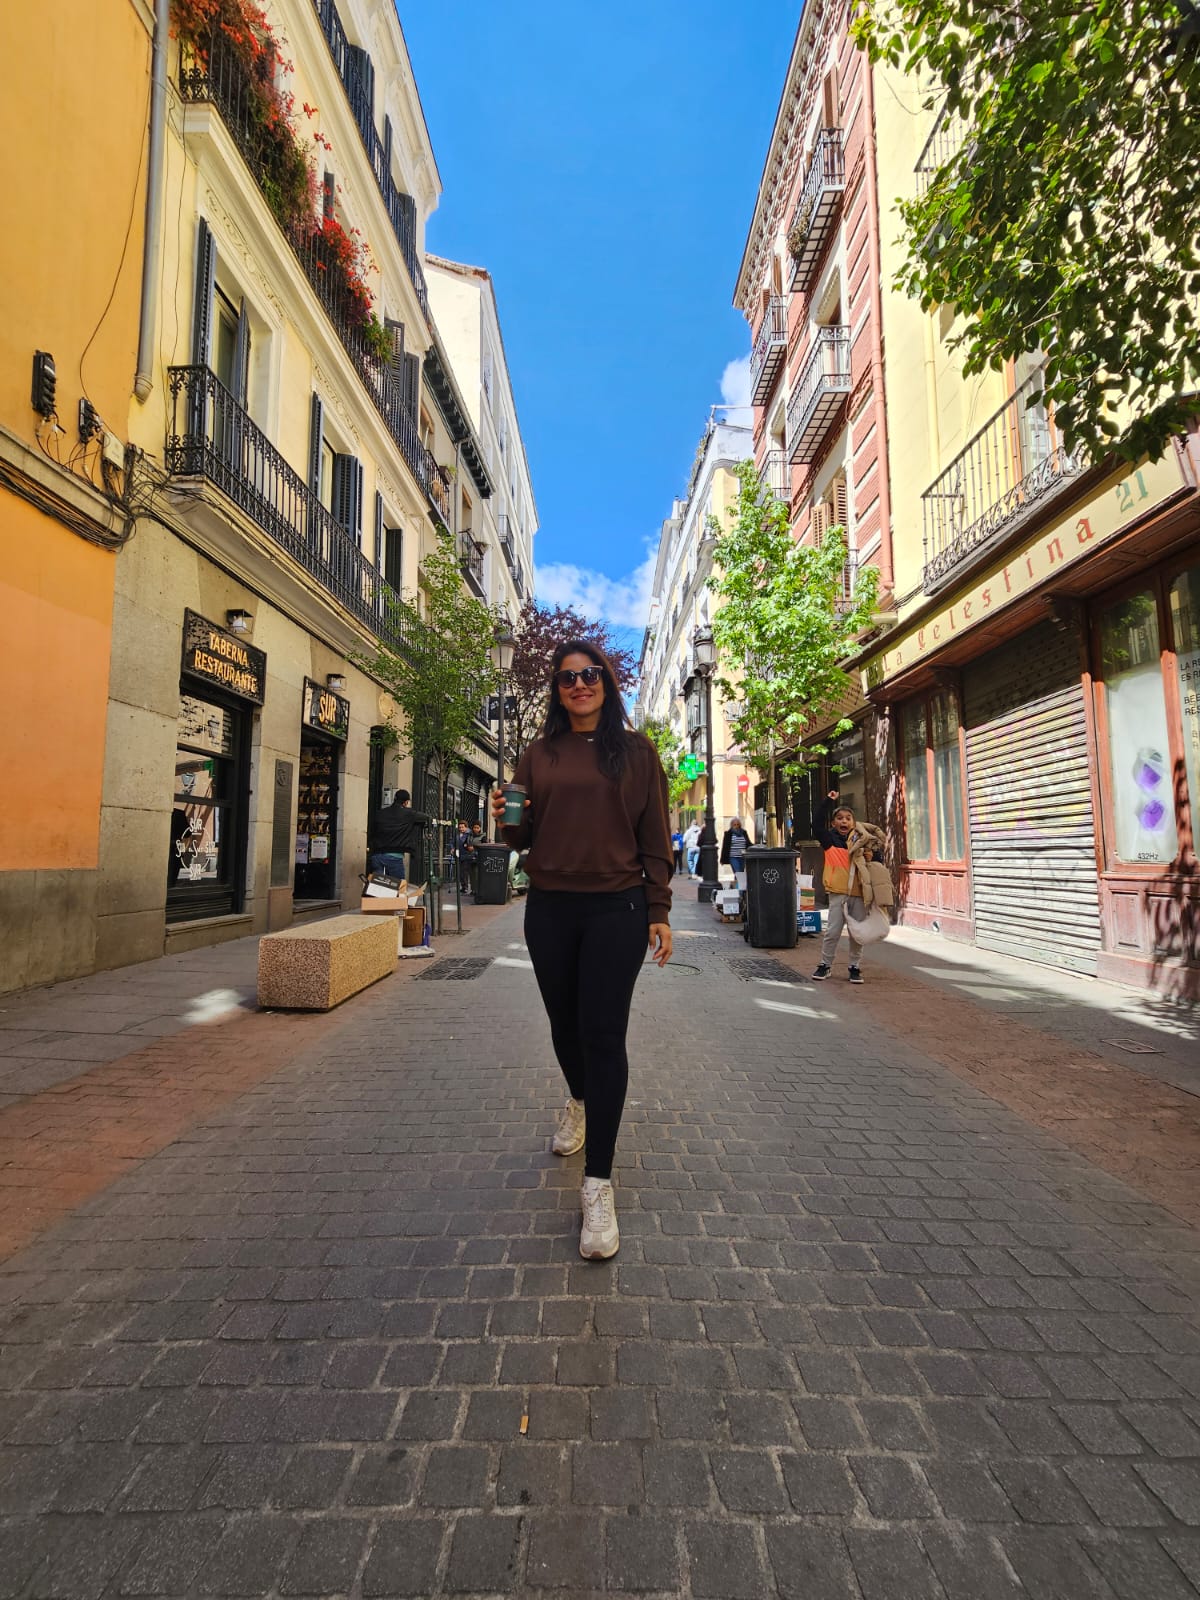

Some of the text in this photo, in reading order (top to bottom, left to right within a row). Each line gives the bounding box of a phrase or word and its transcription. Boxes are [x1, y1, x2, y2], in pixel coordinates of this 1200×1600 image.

[882, 651, 903, 673] La
[917, 516, 1096, 650] Celestina
[1115, 470, 1149, 513] 21
[209, 631, 249, 667] TABERNA
[194, 648, 258, 693] RESTAURANTE
[319, 692, 337, 723] SUR
[189, 818, 203, 833] SUR
